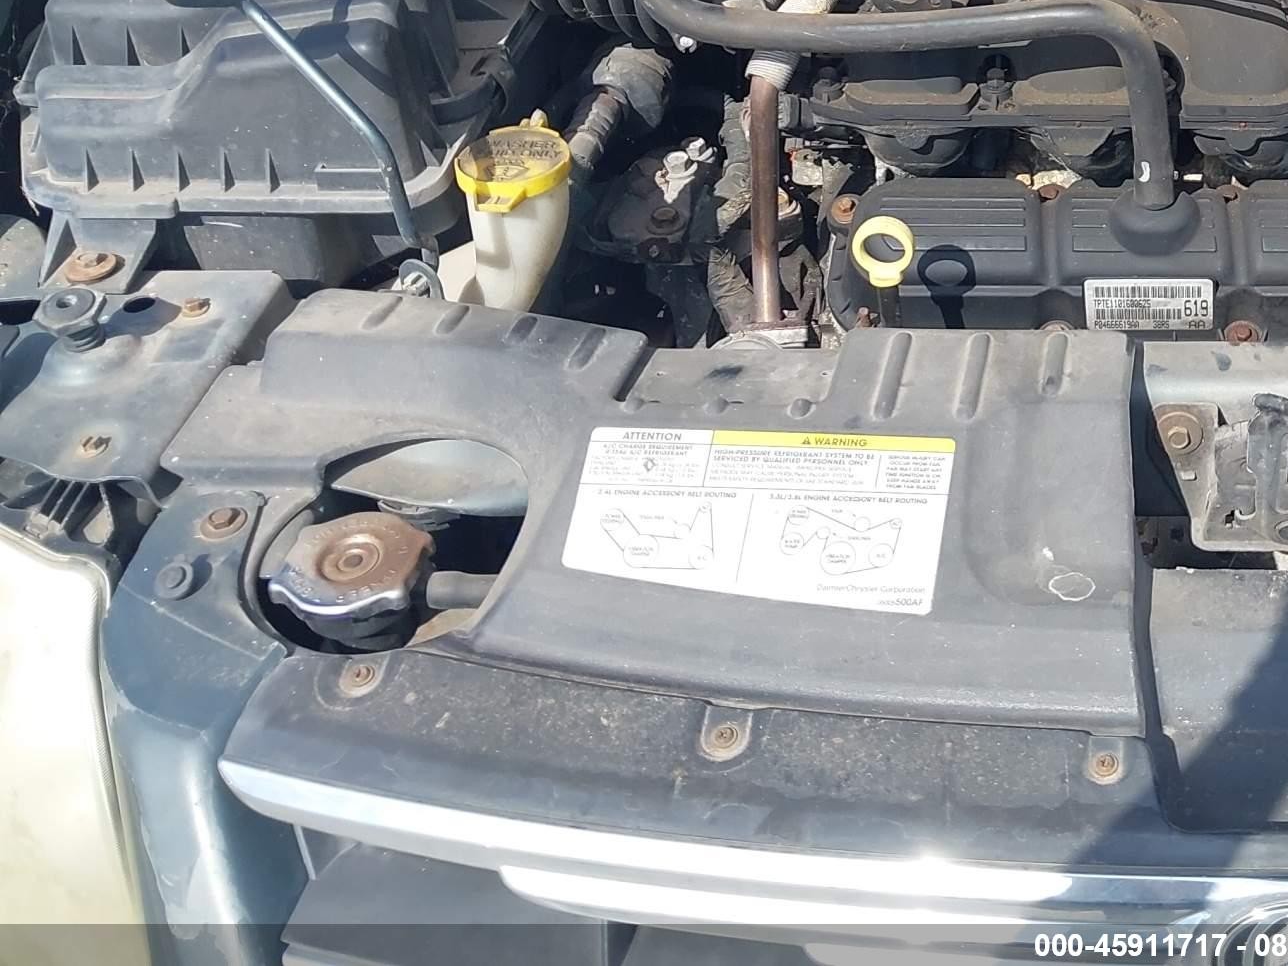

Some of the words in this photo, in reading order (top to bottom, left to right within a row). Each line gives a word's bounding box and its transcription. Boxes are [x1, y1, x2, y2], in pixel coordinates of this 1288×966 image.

[1184, 299, 1209, 317] 619
[1188, 320, 1206, 329] AA
[622, 431, 682, 441] ATTENTION
[814, 437, 867, 447] WARNING
[832, 495, 876, 503] ACCESSORY
[816, 584, 878, 593] DaimlerChrysler
[880, 585, 925, 594] Corporation
